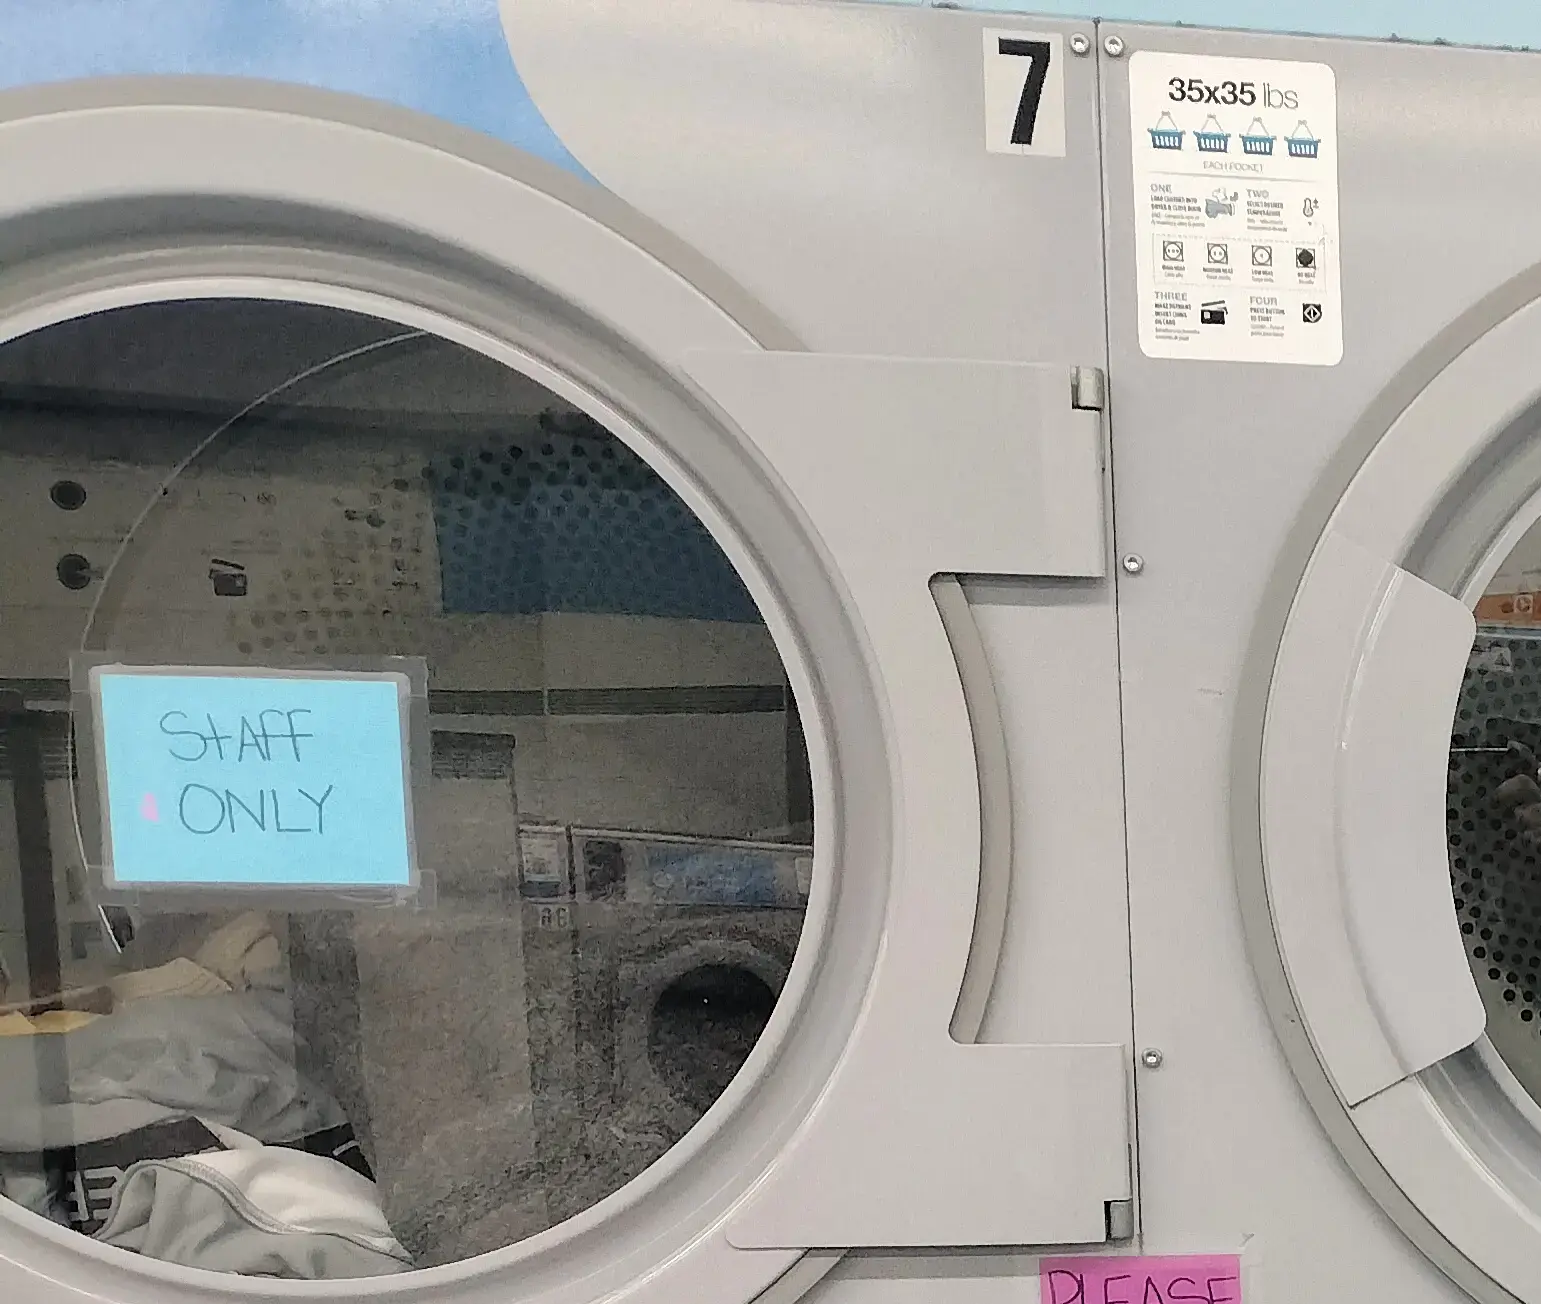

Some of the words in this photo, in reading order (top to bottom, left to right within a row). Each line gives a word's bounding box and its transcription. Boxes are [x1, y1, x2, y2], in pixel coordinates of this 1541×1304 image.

[998, 37, 1050, 145] 7
[1168, 77, 1257, 106] 35x35
[1263, 82, 1299, 111] lbs
[1246, 189, 1269, 198] TWO
[1154, 291, 1187, 301] THREE
[1250, 296, 1277, 305] FOUR
[179, 783, 333, 834] ONLY
